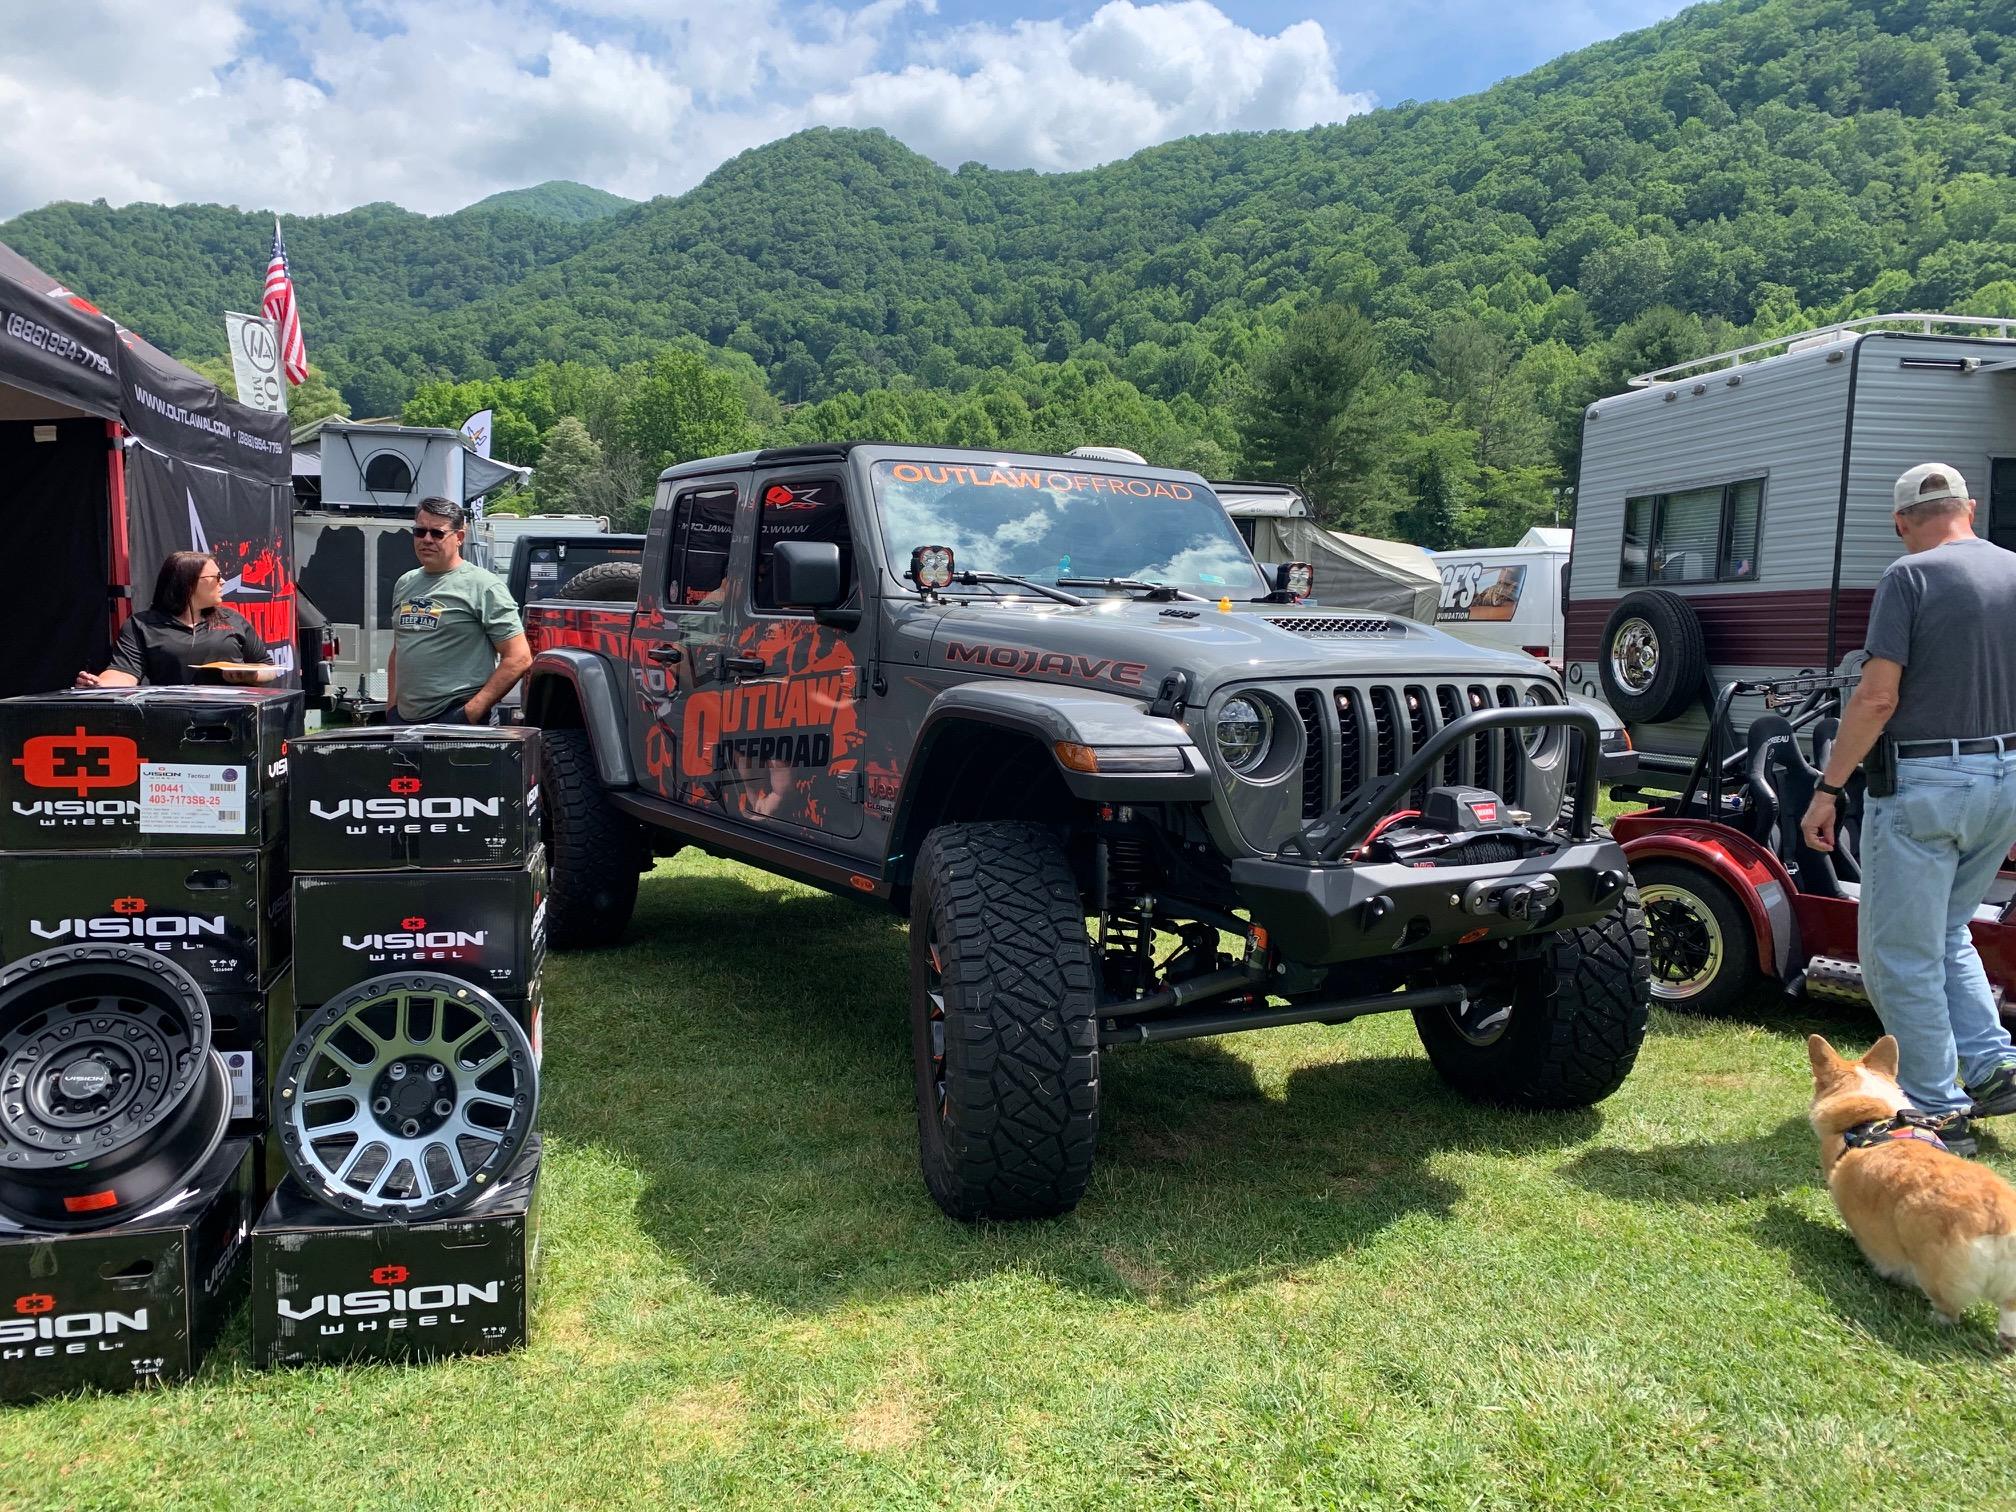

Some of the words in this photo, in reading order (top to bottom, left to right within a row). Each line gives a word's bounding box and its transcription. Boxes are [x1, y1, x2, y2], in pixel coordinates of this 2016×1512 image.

[892, 463, 1041, 489] OUTLAW
[1046, 472, 1193, 501] OFFROAD
[401, 616, 419, 624] JEEP
[419, 617, 436, 627] JAM
[1436, 612, 1470, 620] OUNDATION
[945, 641, 1148, 687] MOJAVE
[682, 676, 842, 776] OUTLAW
[721, 733, 831, 770] OFFROAD
[149, 783, 184, 793] 100441
[12, 800, 140, 816] VISIO
[149, 794, 221, 806] 403-7173SB-25
[309, 797, 499, 820] VISION
[39, 818, 135, 826] WHEEL
[346, 823, 471, 835] WHEEL
[30, 916, 225, 939] VISION
[342, 930, 484, 951] VISION
[369, 951, 463, 962] WHEEL
[278, 1280, 499, 1321] VISION
[0, 1308, 148, 1342] SION
[320, 1313, 465, 1336] WHEEL
[3, 1341, 114, 1360] HEEL
